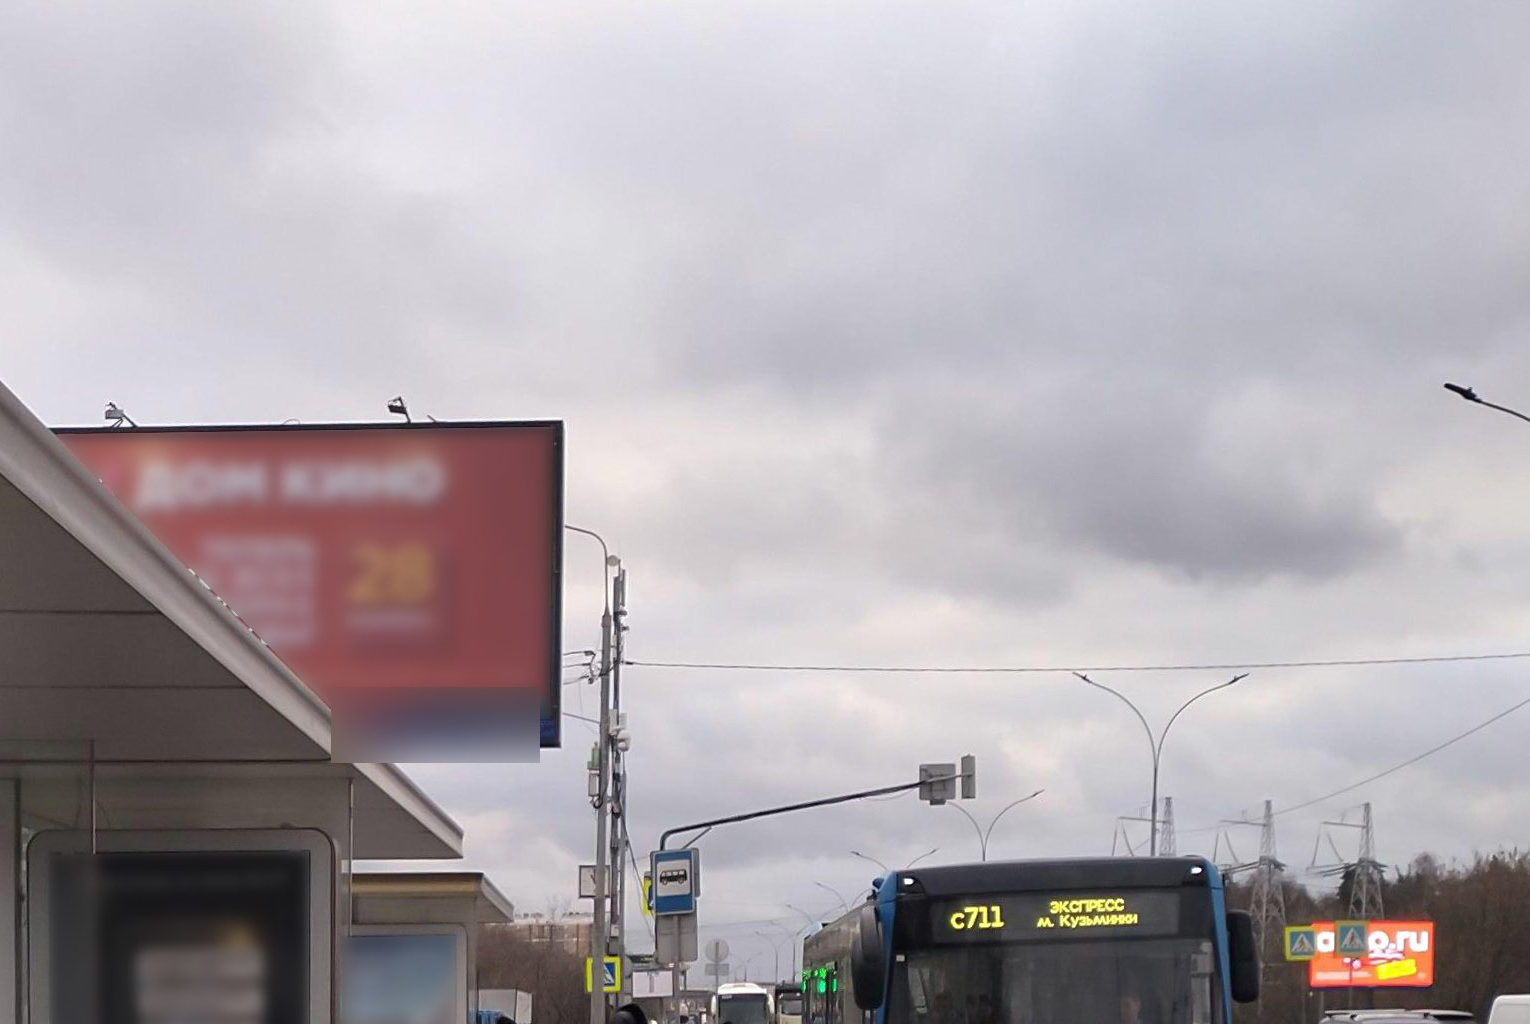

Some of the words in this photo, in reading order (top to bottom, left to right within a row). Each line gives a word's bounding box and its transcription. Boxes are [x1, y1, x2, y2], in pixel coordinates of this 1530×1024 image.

[1049, 898, 1125, 914] ЭКСПРЕСС
[950, 905, 1004, 929] с711
[1060, 914, 1138, 928] Кузьминки
[1317, 931, 1428, 952] ao.ru
